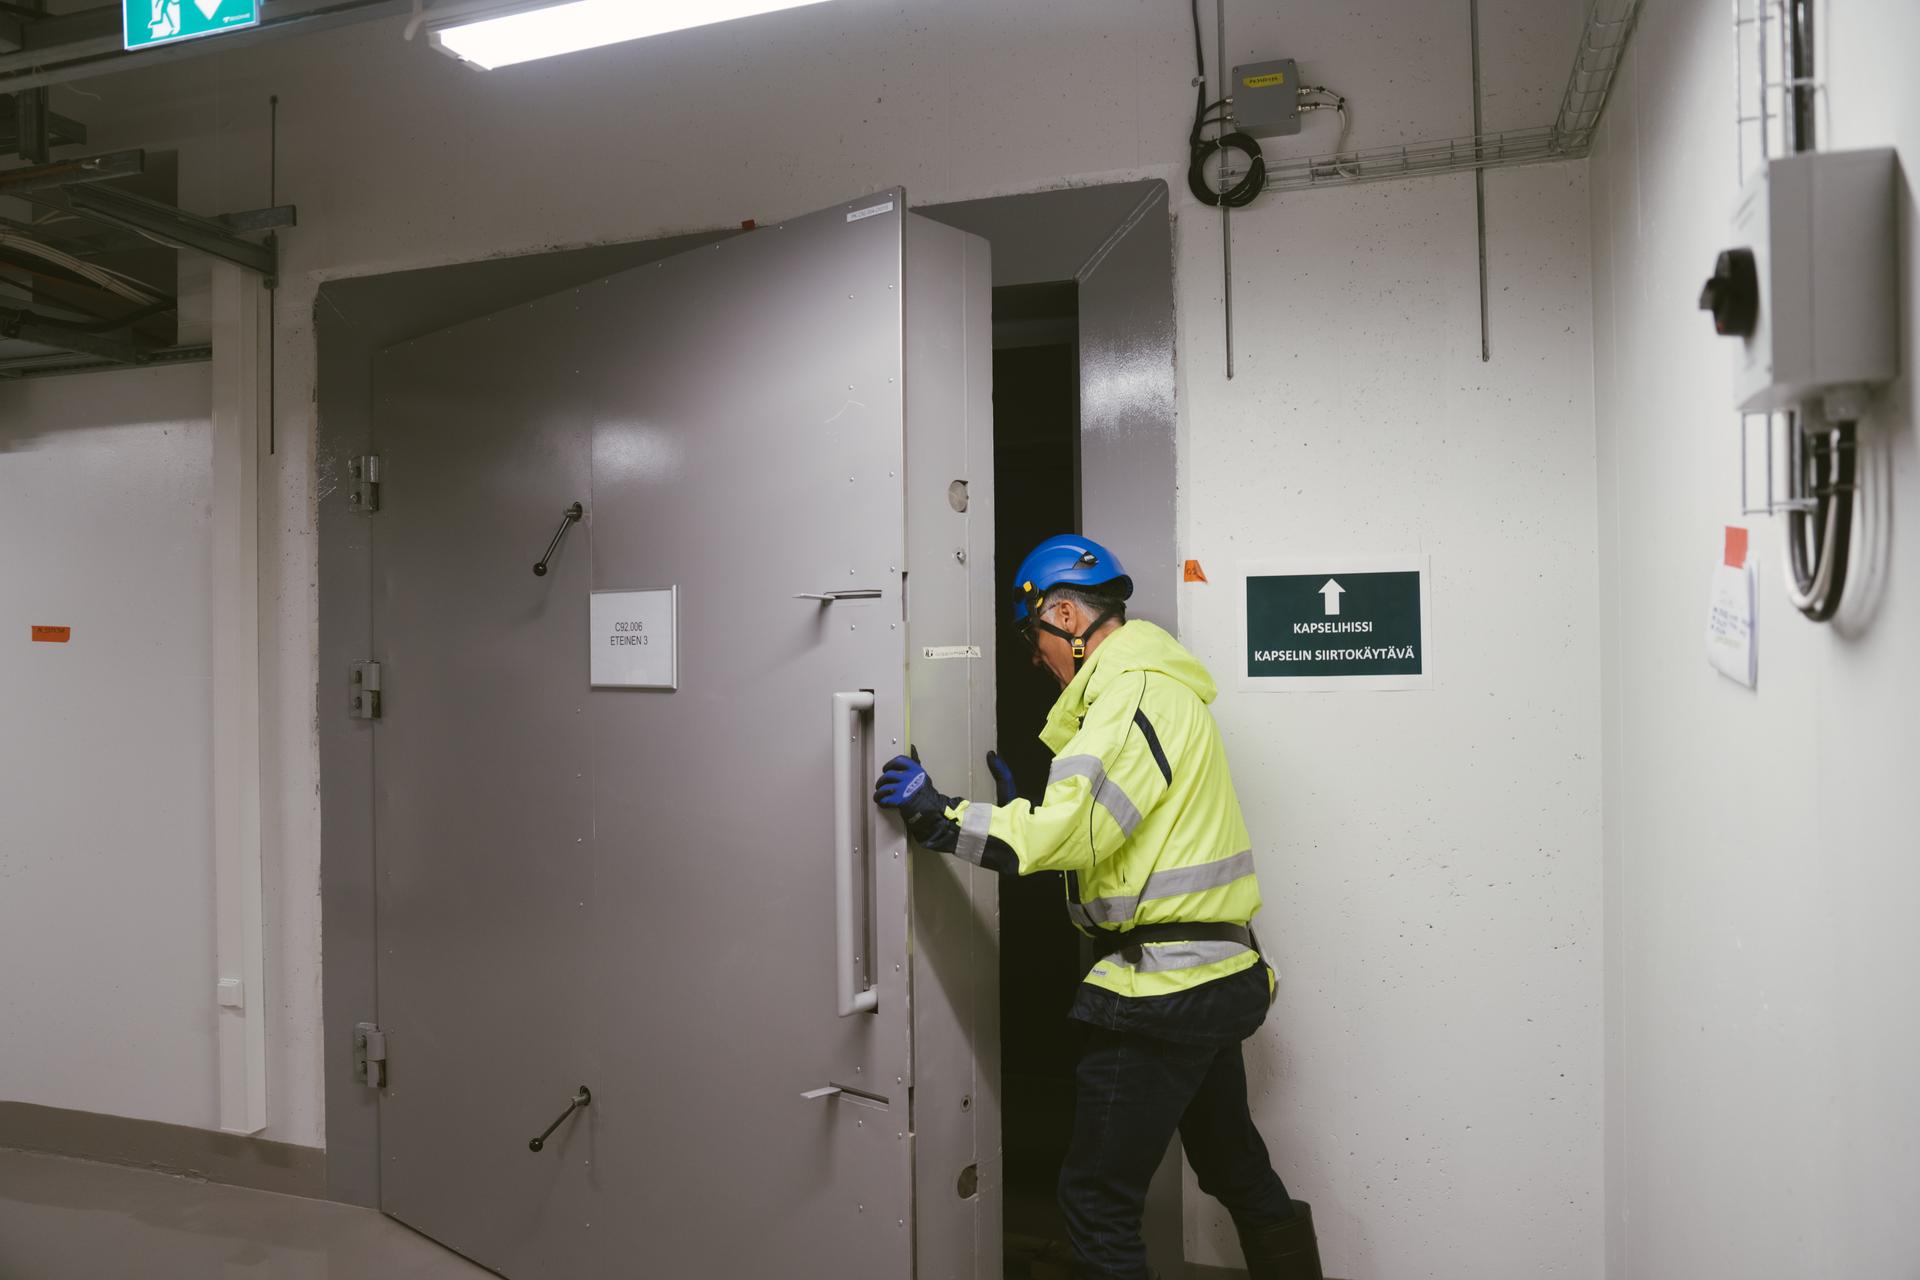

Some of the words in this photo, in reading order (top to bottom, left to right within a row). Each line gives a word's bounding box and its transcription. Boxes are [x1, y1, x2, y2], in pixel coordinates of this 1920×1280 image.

[615, 621, 643, 632] C92.006
[1293, 621, 1373, 634] KAPSELIHISSI
[610, 635, 642, 646] ETEINEN
[643, 635, 649, 646] 3
[1254, 649, 1312, 662] KAPSELIN
[1315, 645, 1415, 661] SIIRTOKÄYTÄVÄ
